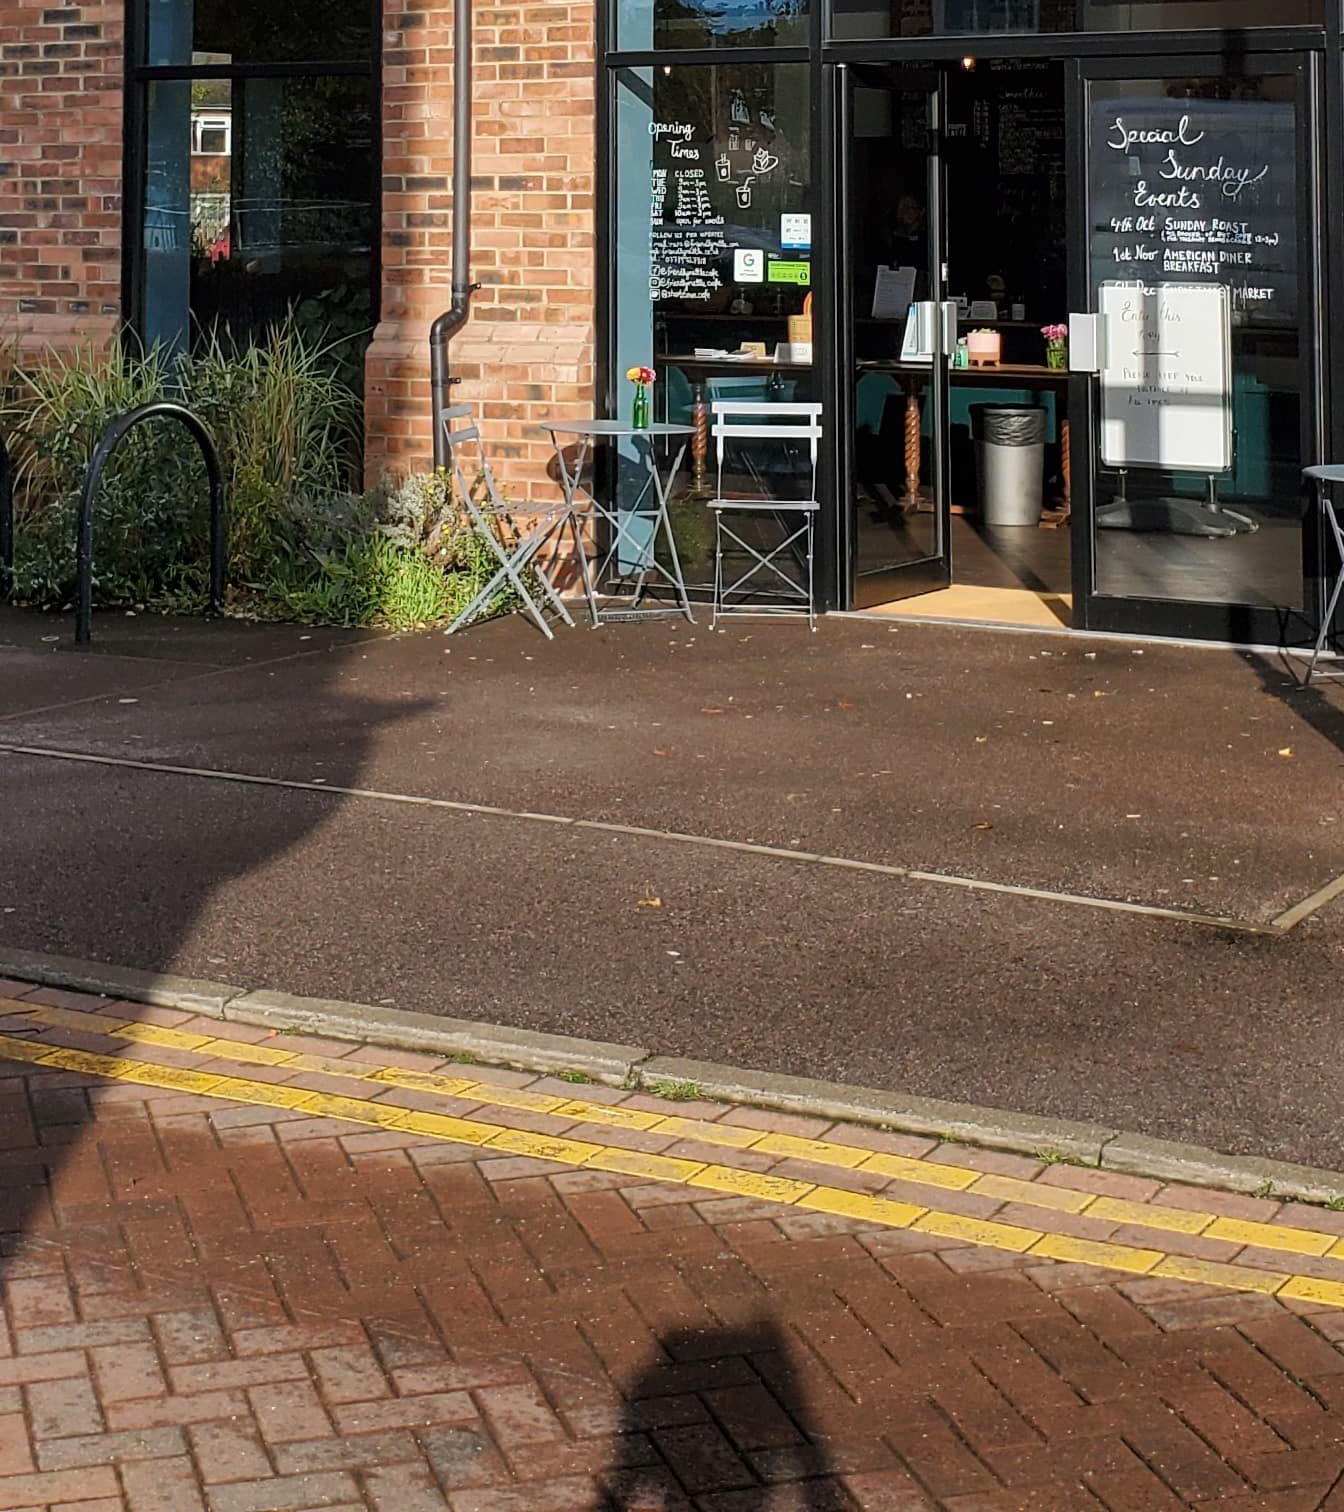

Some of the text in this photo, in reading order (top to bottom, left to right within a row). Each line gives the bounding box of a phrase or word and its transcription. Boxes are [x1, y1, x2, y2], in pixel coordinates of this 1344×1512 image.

[648, 121, 696, 141] Opening
[1108, 115, 1204, 153] Special
[666, 139, 700, 159] Times
[675, 169, 704, 178] CLOSED
[1159, 149, 1268, 196] Sunday
[1134, 180, 1200, 209] Events
[1136, 217, 1155, 232] Oct
[1165, 217, 1206, 232] SUNDAY
[1212, 219, 1249, 234] ROAST
[1163, 249, 1217, 263] AMERICAN
[1219, 251, 1253, 264] DINER
[1163, 261, 1219, 274] BREAKFAST
[1232, 288, 1275, 299] MARKET
